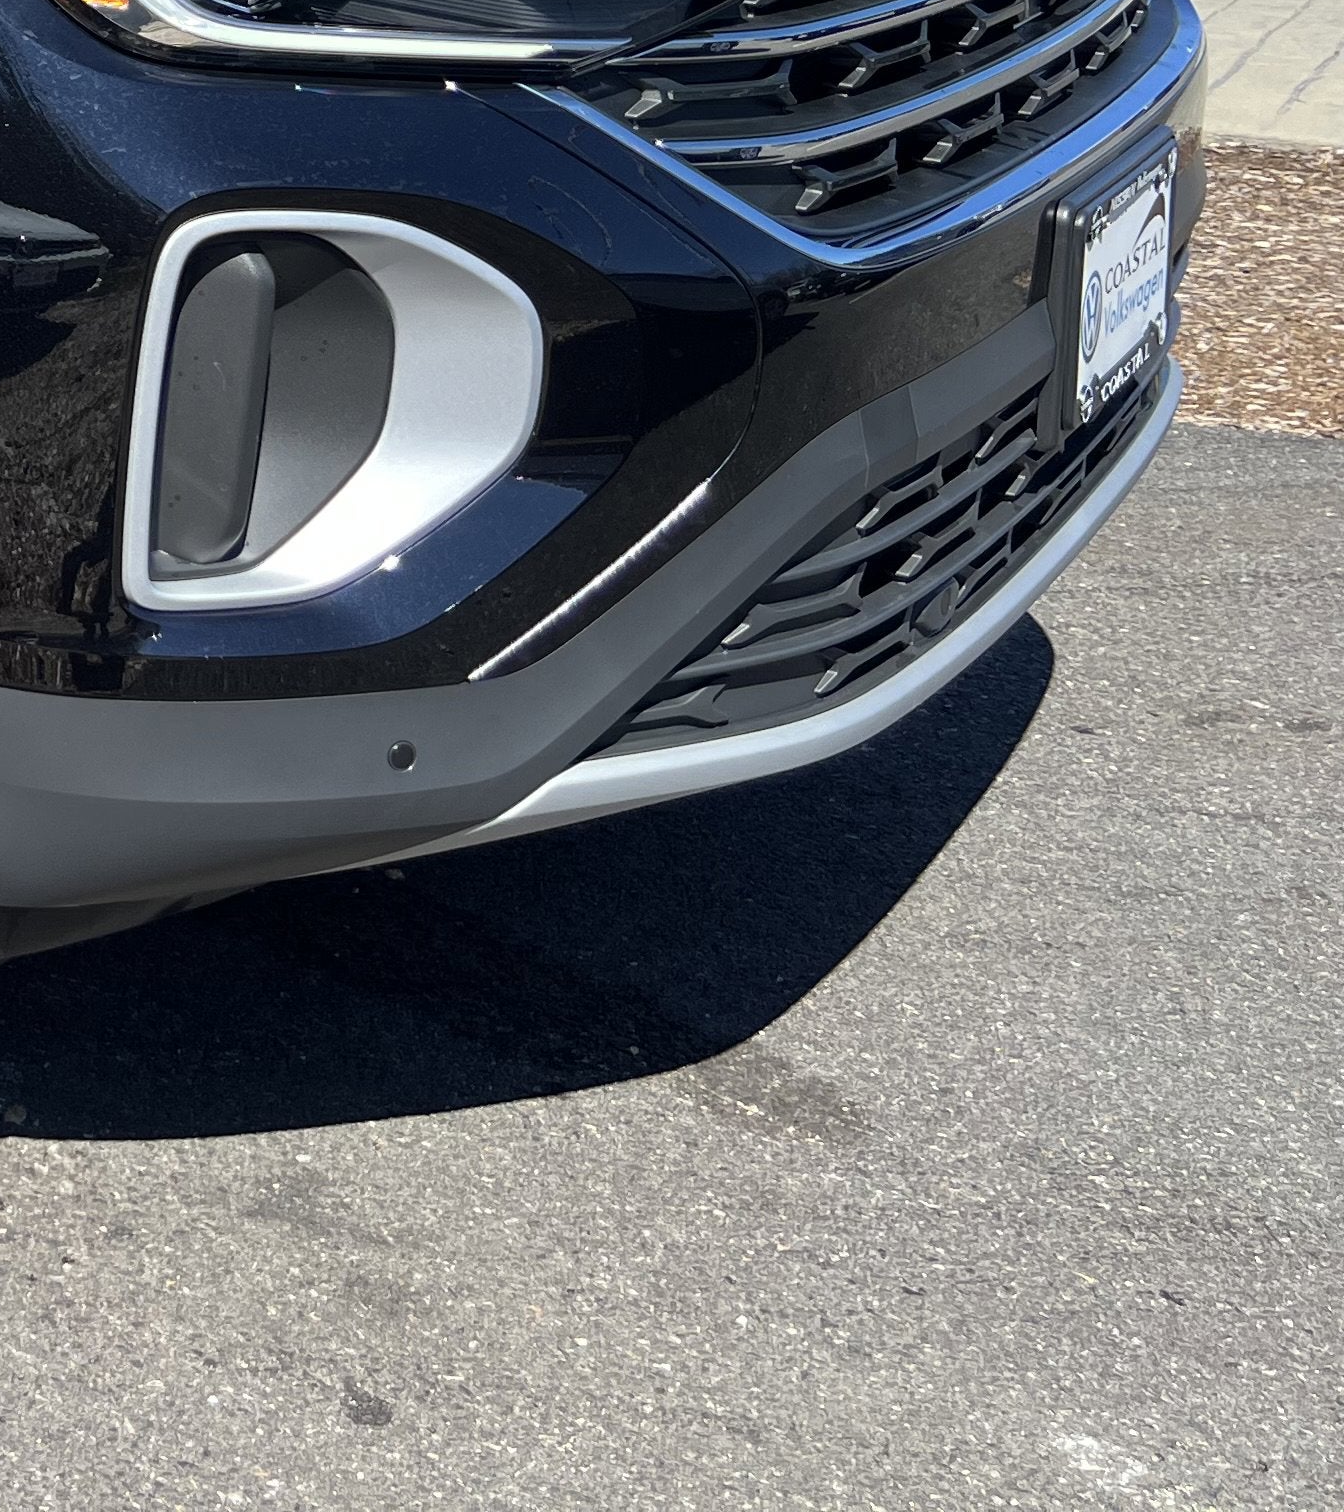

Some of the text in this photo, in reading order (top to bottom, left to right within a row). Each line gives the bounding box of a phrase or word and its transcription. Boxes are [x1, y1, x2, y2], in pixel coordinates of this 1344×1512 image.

[1104, 228, 1165, 294] COASTAL
[1104, 268, 1165, 336] Volkswagen
[1101, 342, 1150, 402] COASTAL
